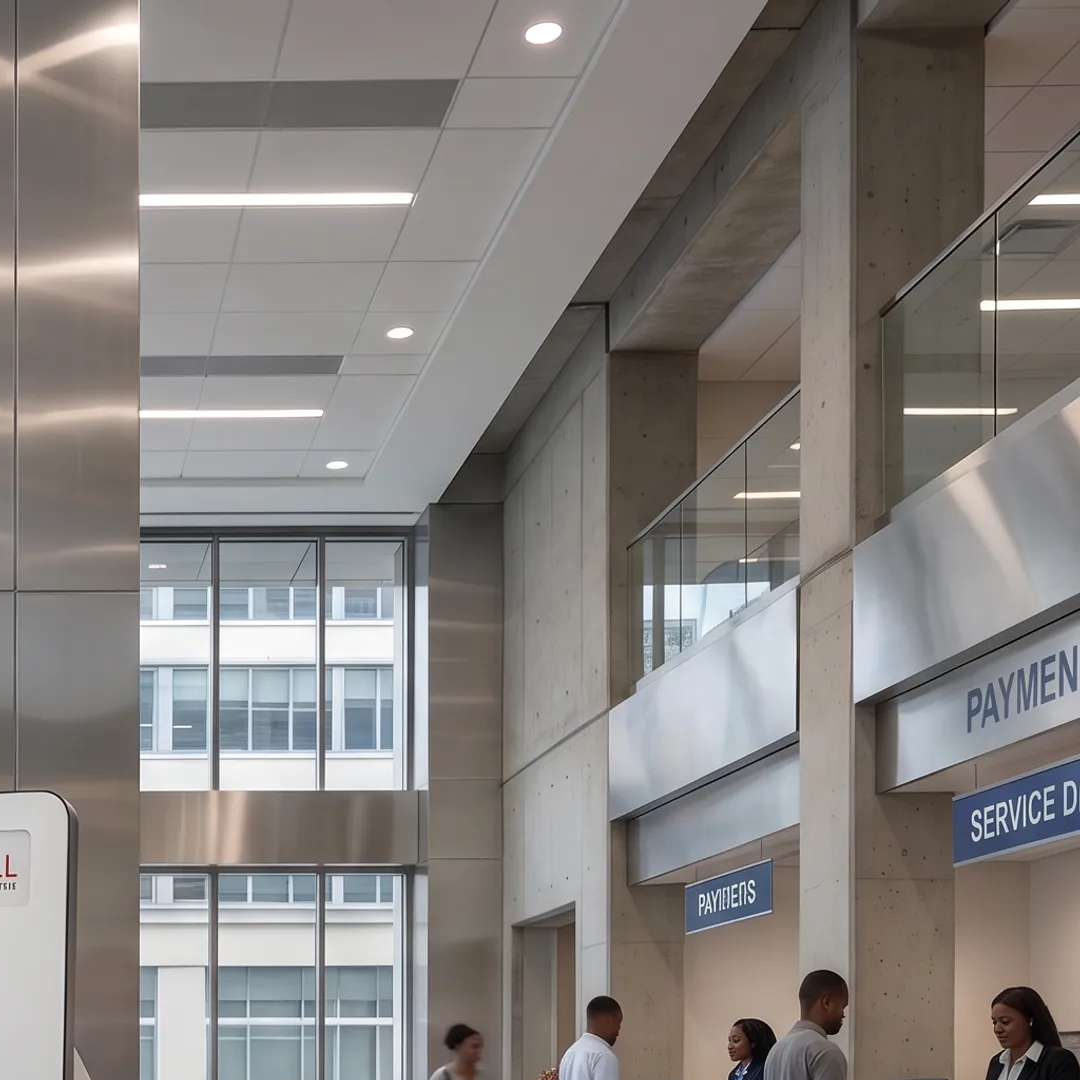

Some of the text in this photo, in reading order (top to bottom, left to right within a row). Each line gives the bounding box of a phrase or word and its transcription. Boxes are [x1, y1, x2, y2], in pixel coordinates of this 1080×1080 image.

[967, 645, 1078, 734] PAYMEN
[970, 780, 1080, 843] SERVICE D
